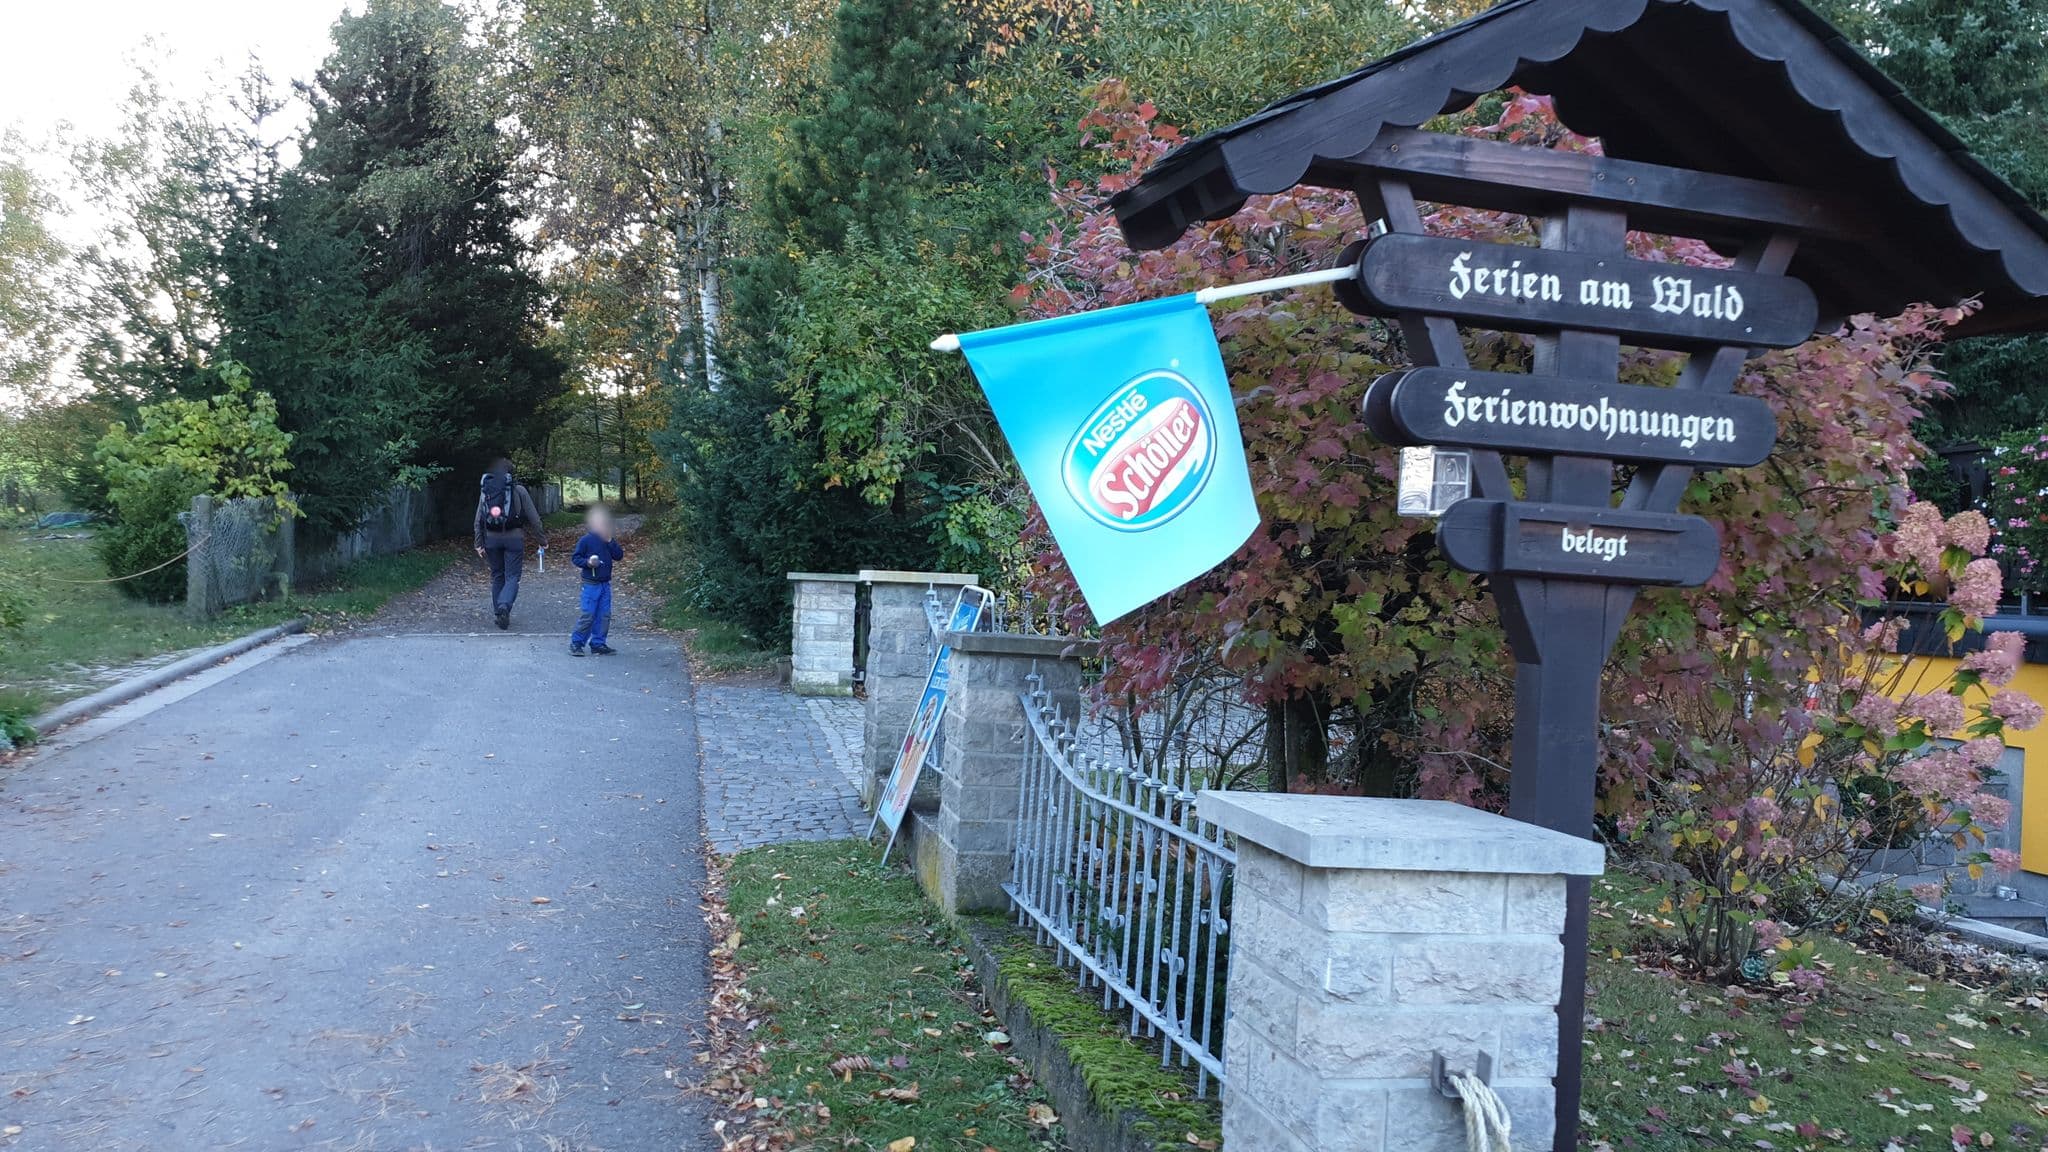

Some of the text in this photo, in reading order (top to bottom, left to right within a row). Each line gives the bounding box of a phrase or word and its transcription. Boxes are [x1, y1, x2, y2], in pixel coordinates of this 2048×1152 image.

[1449, 252, 1744, 322] Ferien am Wald
[1082, 389, 1148, 456] Nestlé
[1444, 382, 1736, 448] Ferienwohnungen
[1100, 404, 1195, 520] Schöller
[1562, 527, 1628, 561] belegt
